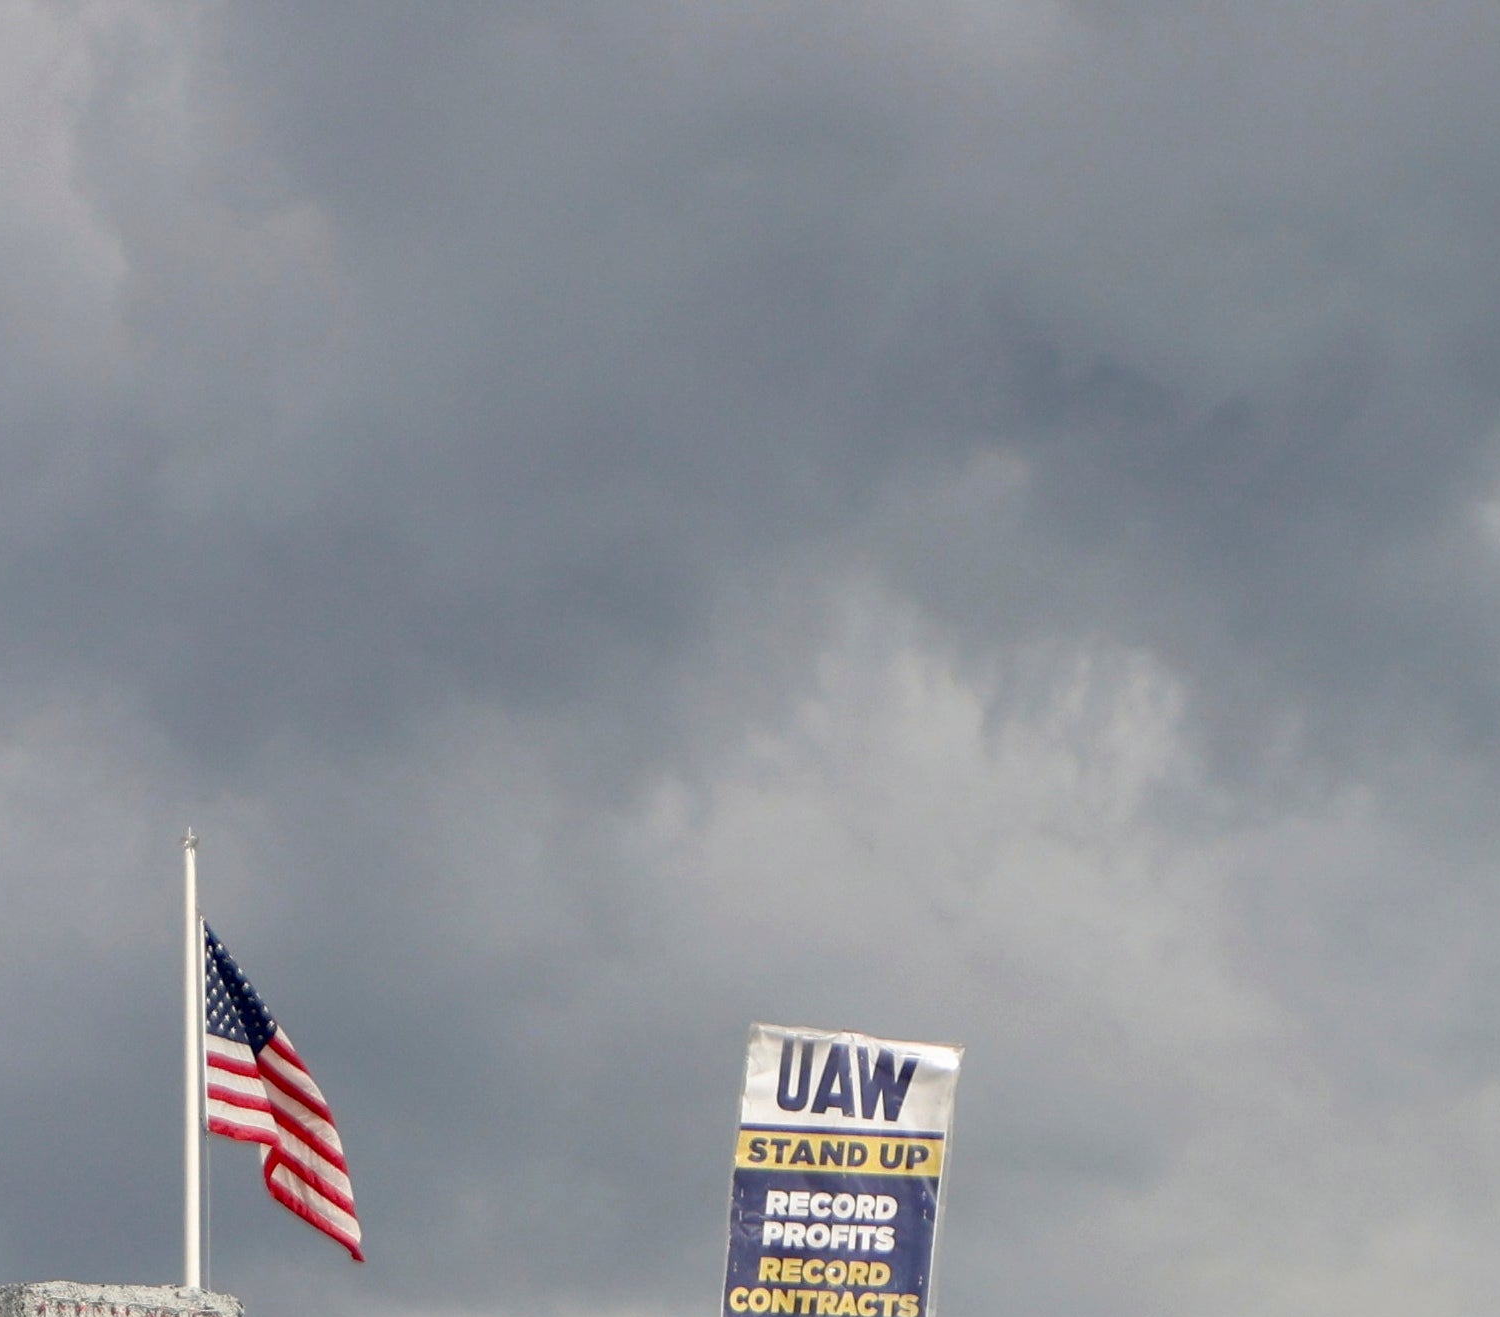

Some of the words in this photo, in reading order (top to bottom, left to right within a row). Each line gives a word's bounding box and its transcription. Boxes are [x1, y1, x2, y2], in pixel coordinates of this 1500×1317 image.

[777, 1039, 918, 1121] UAW
[748, 1137, 868, 1168] STAND
[880, 1144, 929, 1171] UP
[766, 1191, 897, 1220] RECORD
[762, 1221, 895, 1252] PROFITS
[758, 1257, 891, 1286] RECORD
